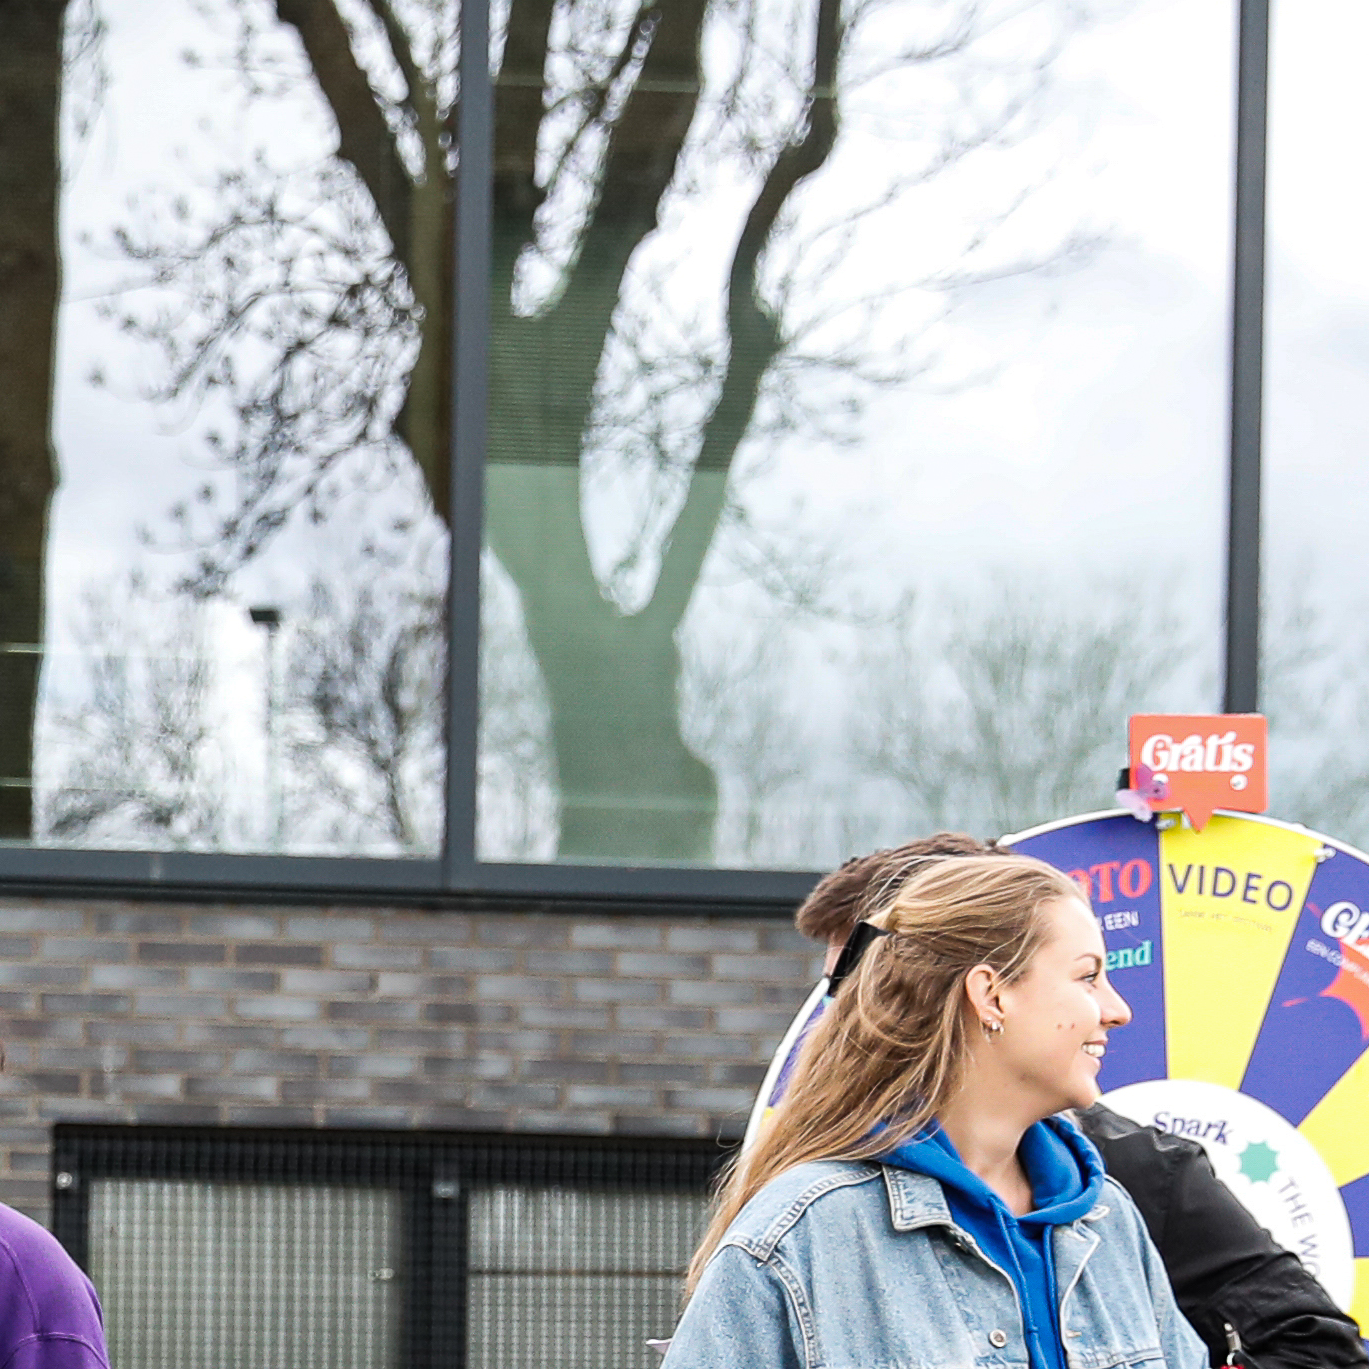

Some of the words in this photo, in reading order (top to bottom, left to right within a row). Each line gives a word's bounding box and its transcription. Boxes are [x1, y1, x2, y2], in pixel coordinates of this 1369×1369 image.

[1141, 731, 1254, 773] Gratis
[1068, 858, 1153, 903] OTO
[1168, 862, 1294, 912] VIDEO
[1106, 940, 1153, 971] end
[1153, 1111, 1234, 1145] Spark
[1278, 1176, 1313, 1229] THE
